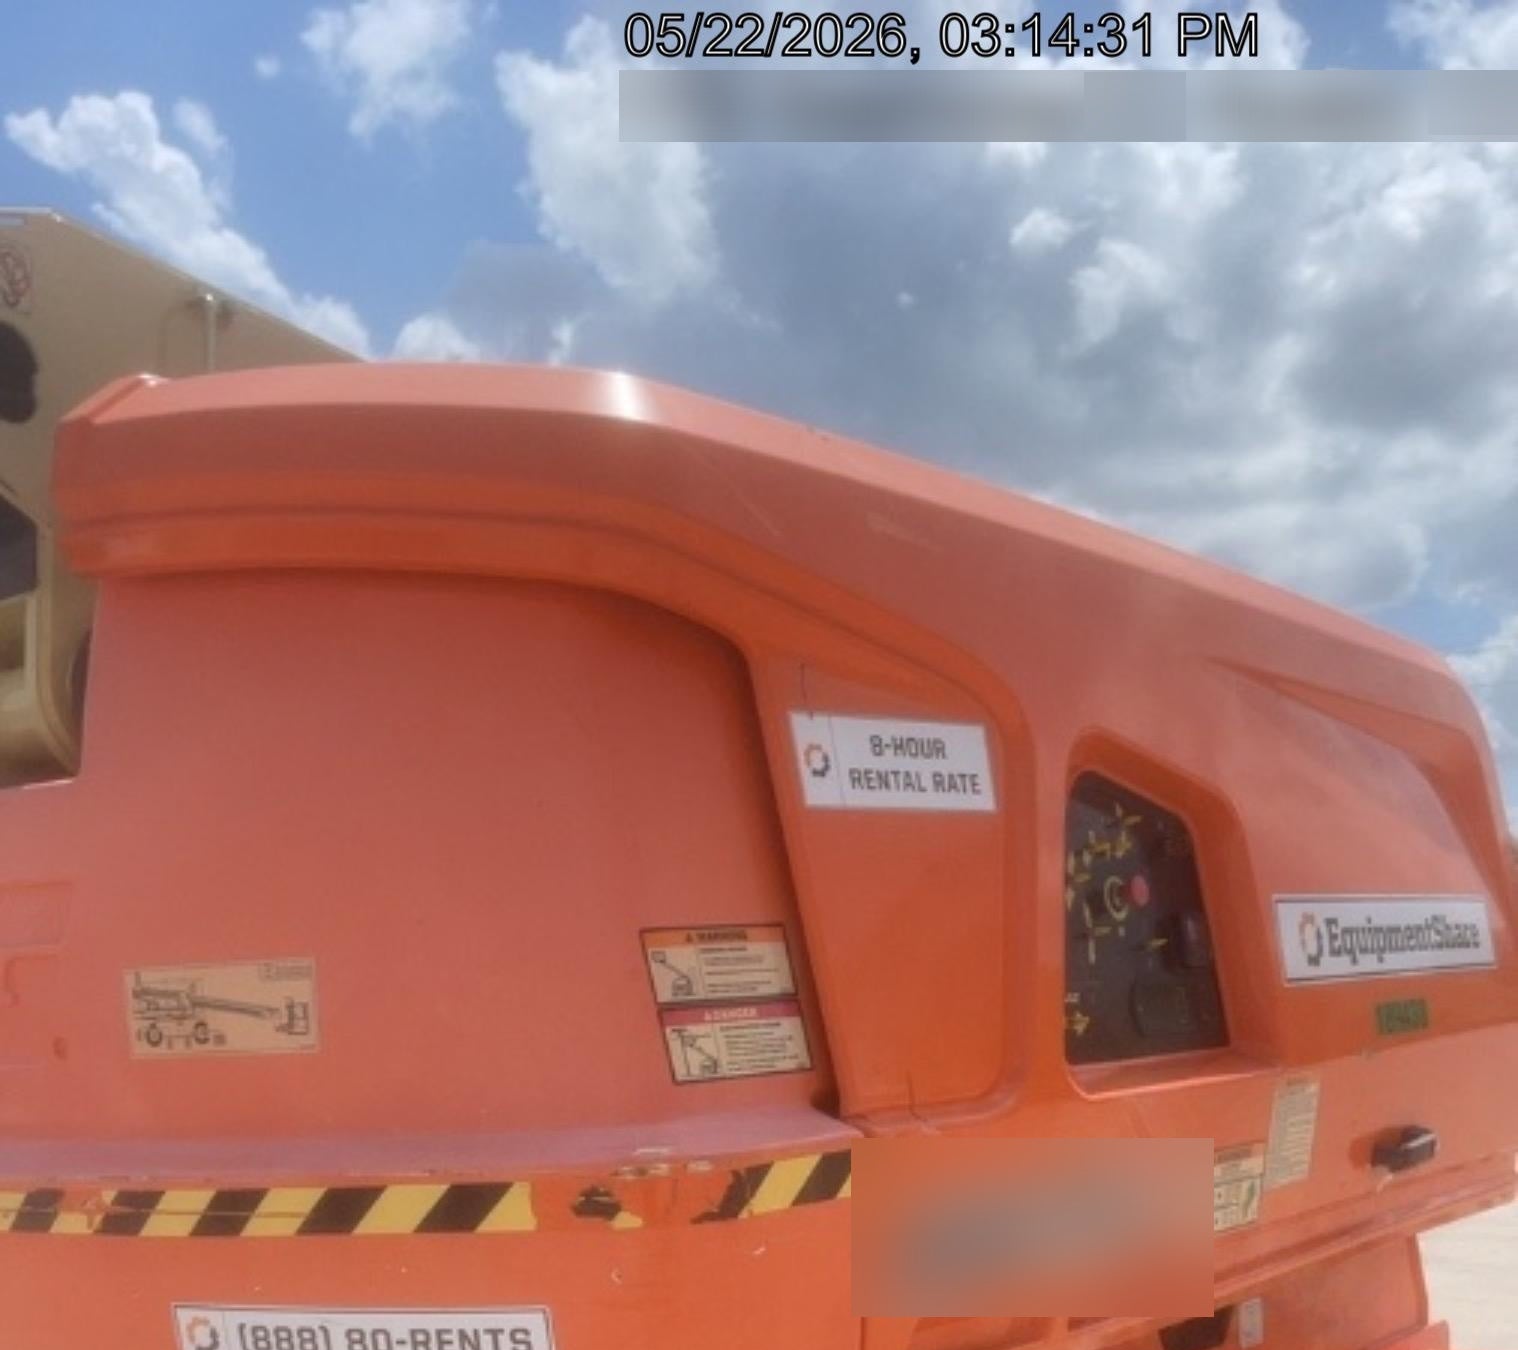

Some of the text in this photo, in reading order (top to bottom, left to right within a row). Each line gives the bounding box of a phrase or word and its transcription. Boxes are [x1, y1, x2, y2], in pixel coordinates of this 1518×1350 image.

[869, 734, 947, 760] 8-HOUR
[848, 768, 982, 795] RENTAL RATE
[1324, 914, 1482, 966] EquipmentShare
